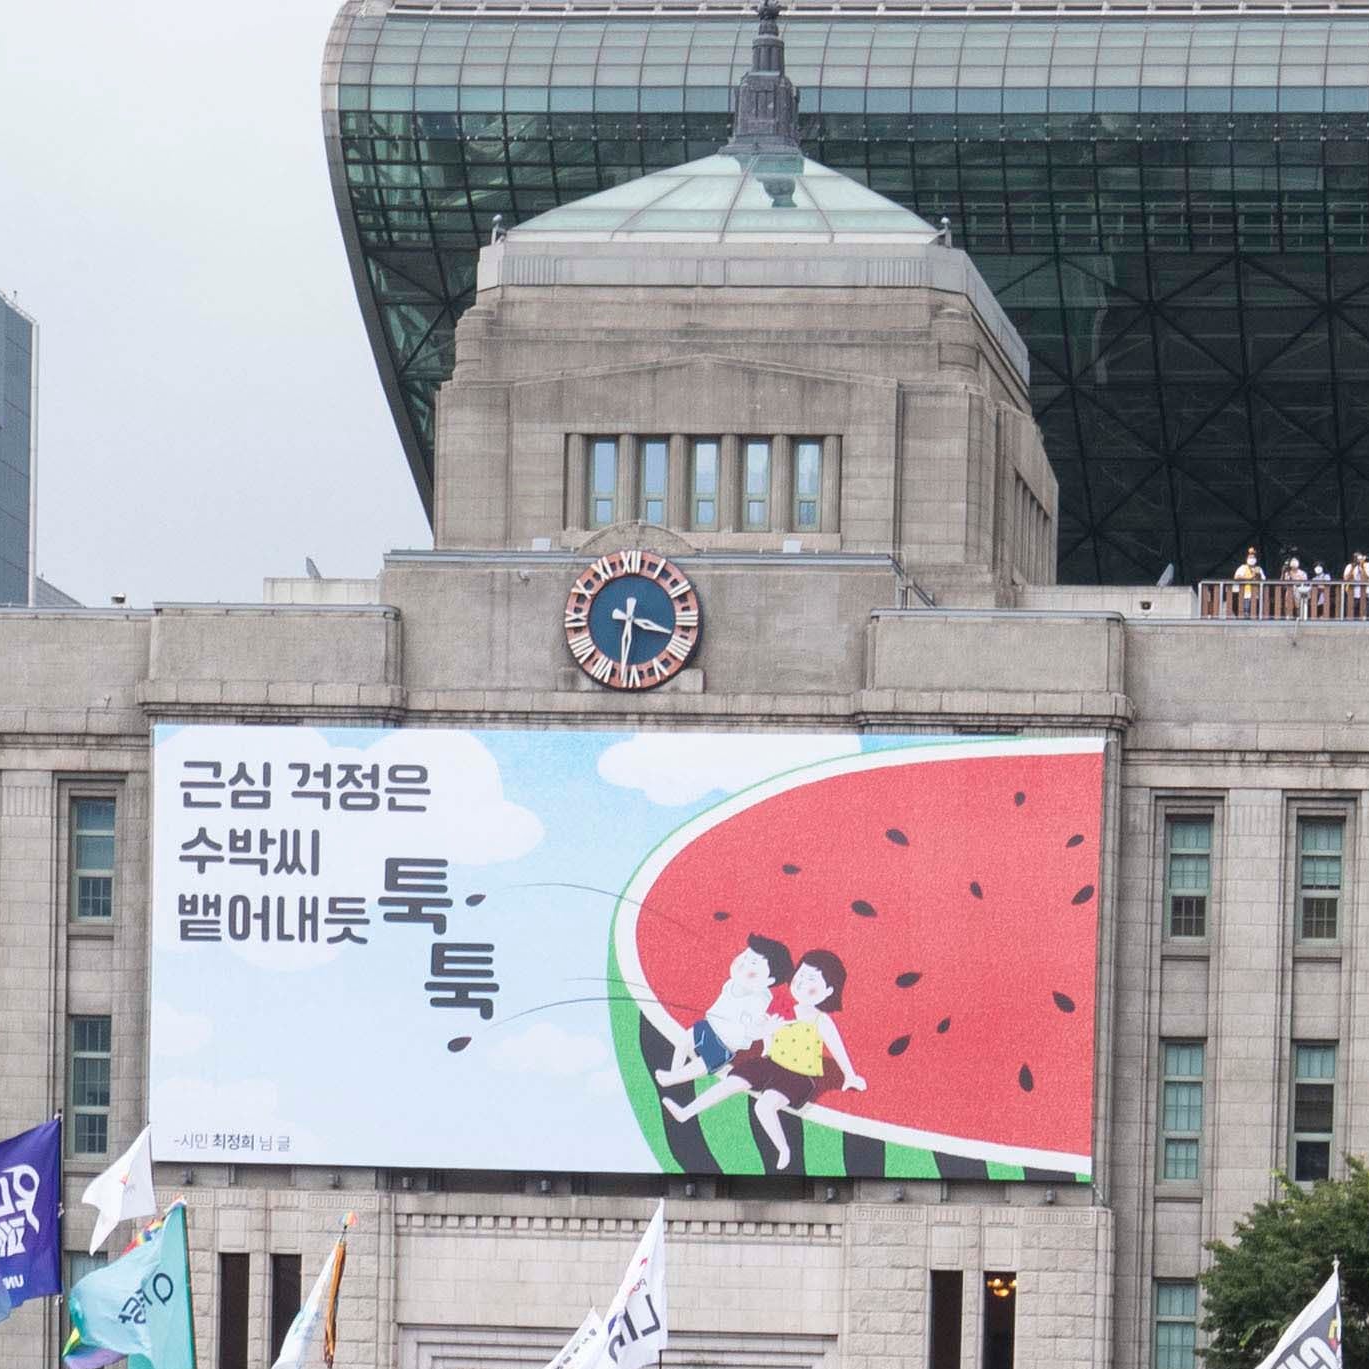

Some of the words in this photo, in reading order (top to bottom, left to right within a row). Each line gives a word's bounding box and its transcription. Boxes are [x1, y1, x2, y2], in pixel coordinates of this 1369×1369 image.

[179, 760, 272, 810] 근심
[287, 762, 432, 813] 걱정은
[178, 826, 321, 877] 수박씨
[177, 893, 371, 945] 뱉어내듯
[377, 857, 454, 936] 툭
[424, 942, 500, 1021] 툭
[212, 1132, 255, 1151] 최정희
[258, 1134, 272, 1152] 님
[276, 1134, 291, 1153] 글
